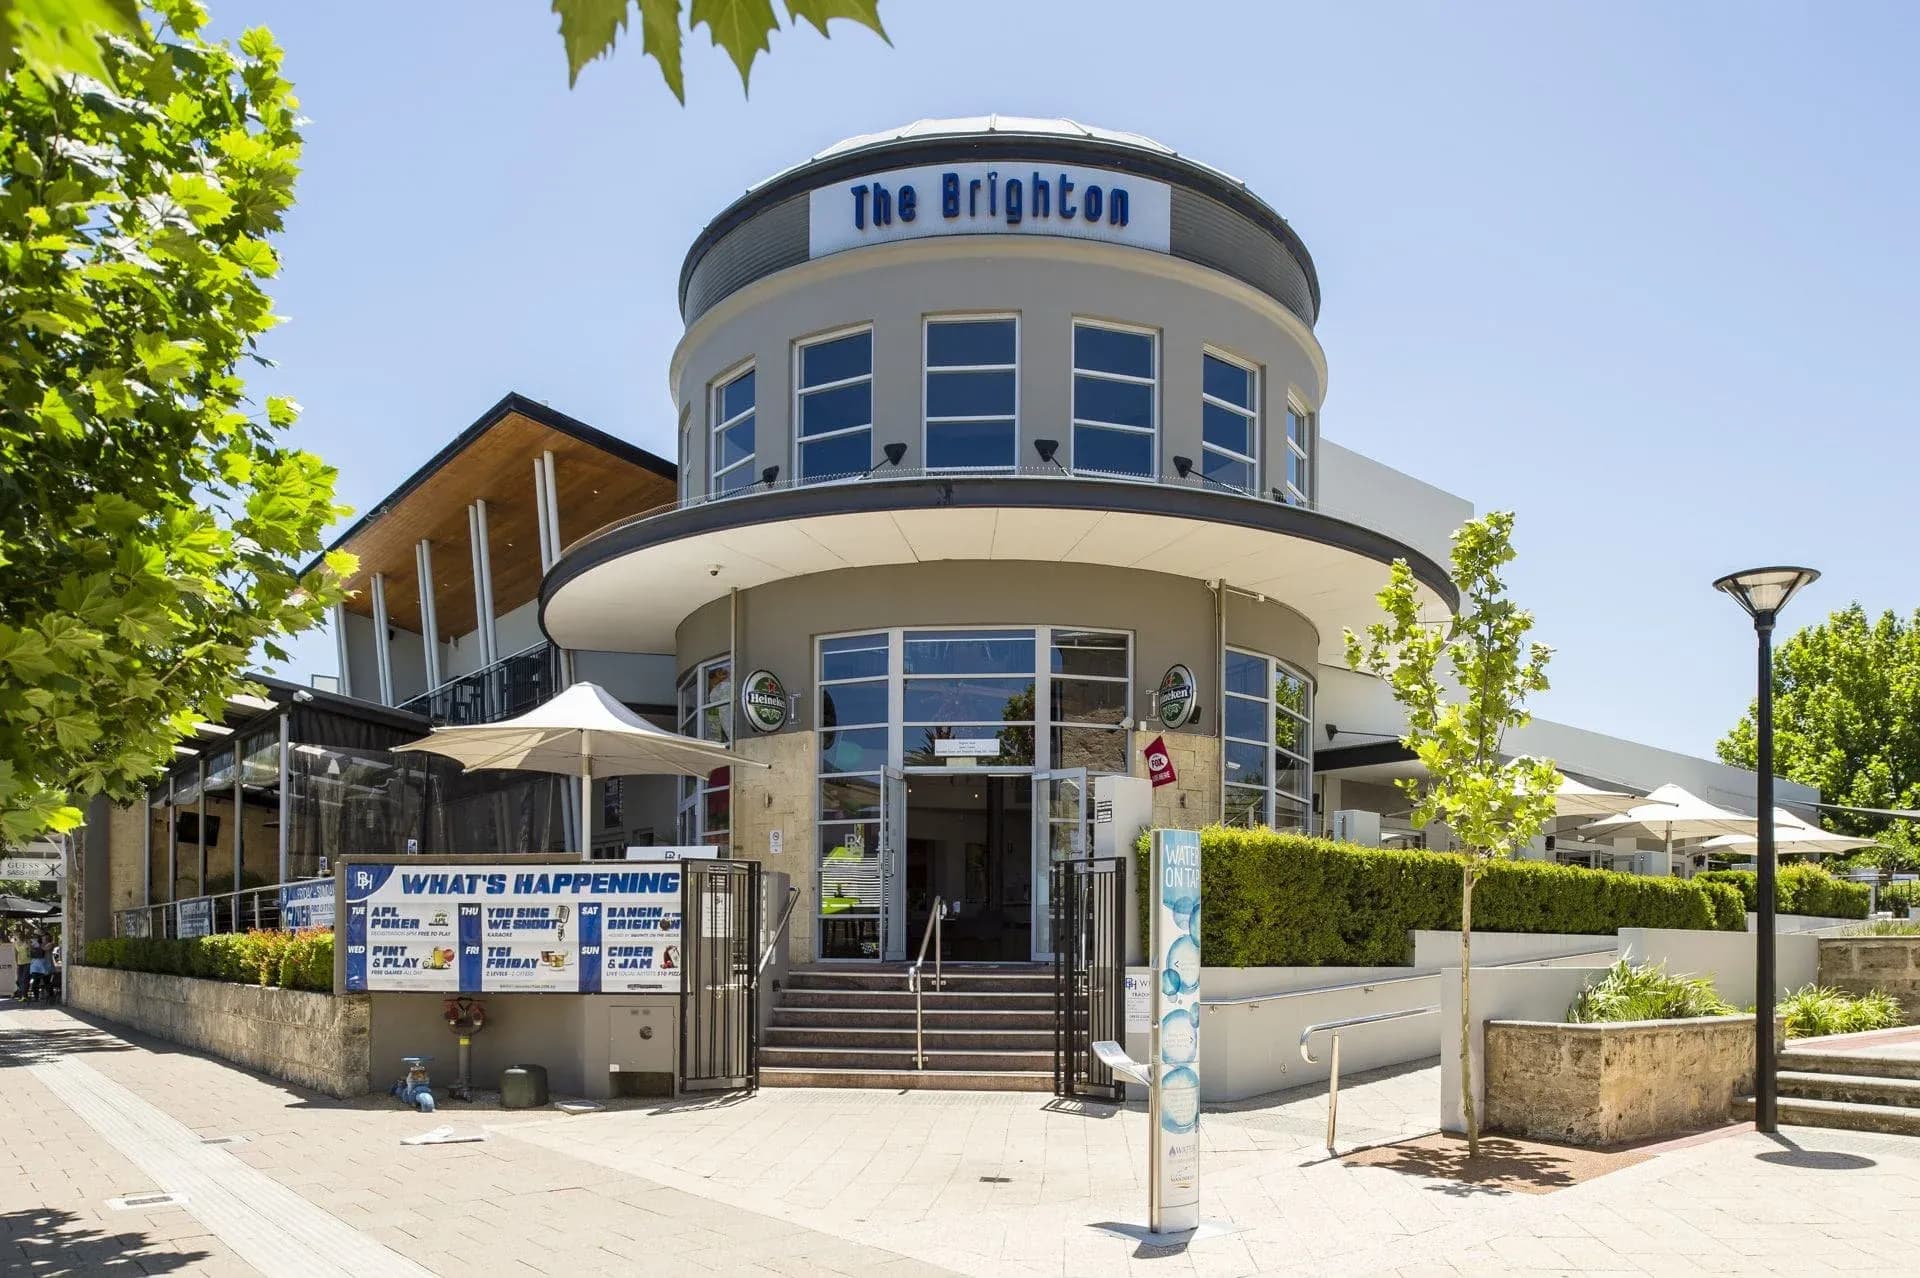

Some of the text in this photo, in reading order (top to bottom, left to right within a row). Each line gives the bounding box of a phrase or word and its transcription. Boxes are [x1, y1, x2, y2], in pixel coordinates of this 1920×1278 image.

[851, 171, 1130, 231] The Brighton
[1165, 843, 1199, 866] WATER
[1165, 867, 1200, 889] ON TAP
[402, 872, 680, 895] WHAT'S HAPPENING
[352, 906, 365, 915] TUE
[371, 907, 399, 917] APL
[461, 907, 479, 916] THU
[487, 908, 550, 918] YOU SING
[582, 907, 599, 916] SAT
[607, 907, 663, 918] BANGIN
[370, 919, 420, 929] POKER
[487, 919, 558, 930] WE SHOUT
[347, 946, 365, 954] WED
[372, 946, 408, 956] PINT
[465, 946, 480, 955] FRI
[487, 947, 512, 957] TGI
[581, 946, 600, 955] SUN
[607, 946, 654, 957] CIDER
[372, 958, 420, 968] & PLAY
[486, 958, 540, 968] FRIDAY
[607, 958, 653, 969] & JAM
